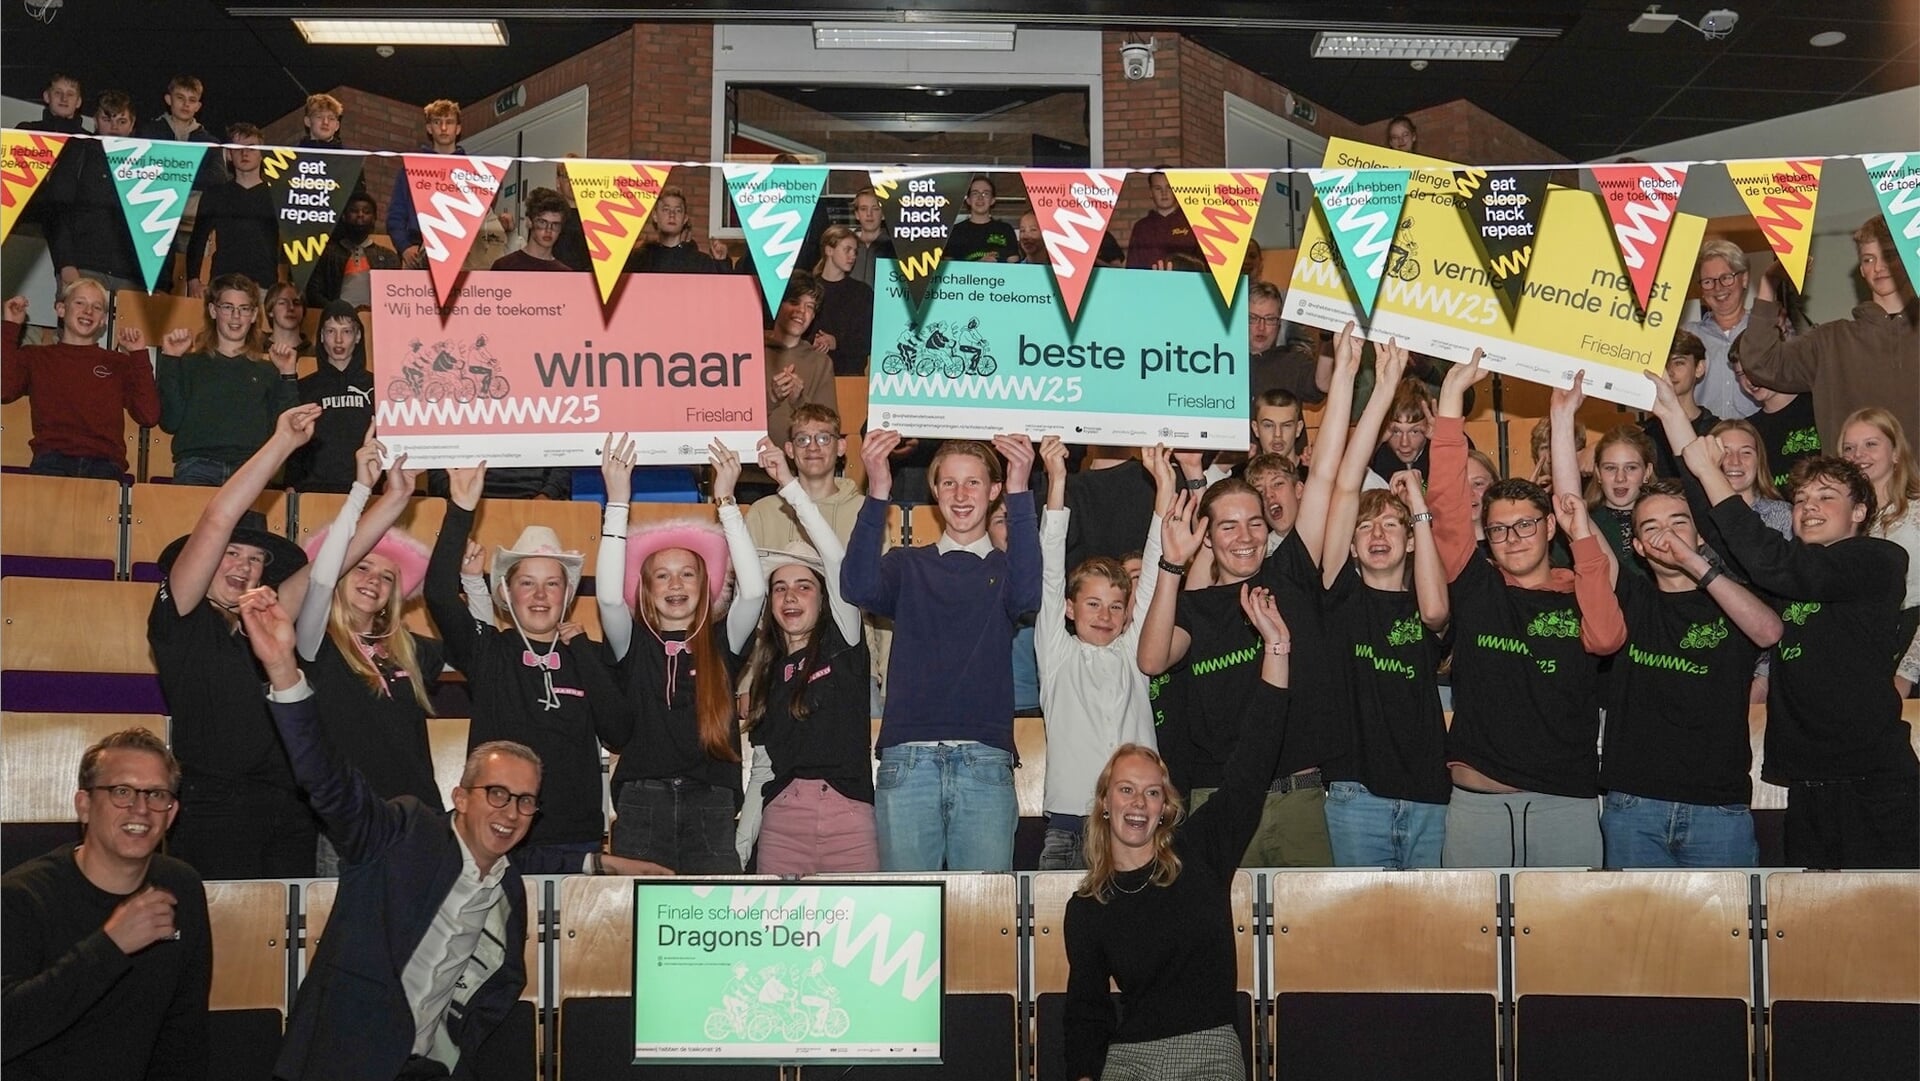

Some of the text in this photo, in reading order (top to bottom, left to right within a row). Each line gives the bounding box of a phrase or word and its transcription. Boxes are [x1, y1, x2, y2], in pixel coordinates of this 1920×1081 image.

[10, 145, 53, 157] hebben
[1, 159, 50, 170] oekomst
[148, 156, 194, 170] hebben
[298, 160, 326, 175] eat
[118, 168, 193, 183] de toekomst
[290, 174, 336, 192] sleep
[450, 169, 496, 184] hebben
[613, 176, 659, 188] hebben
[1638, 177, 1679, 189] hebben
[1772, 171, 1816, 184] hebben
[416, 179, 495, 196] de toekomst
[771, 180, 817, 192] hebben
[908, 178, 936, 193] eat
[1070, 183, 1115, 196] hebben
[1214, 183, 1259, 195] hebben
[1356, 181, 1402, 193] hebben
[1490, 177, 1516, 191] eat
[1745, 182, 1818, 196] de toekomst
[1879, 180, 1894, 191] de
[288, 191, 330, 206] hack
[581, 187, 658, 200] de toekomst
[739, 192, 817, 205] de toekomst
[1184, 195, 1259, 206] de toekomst
[1327, 194, 1402, 207] de toekomst
[1409, 188, 1468, 209] de toeko
[1485, 191, 1527, 208] sleep
[1610, 190, 1678, 201] de toekomst
[901, 193, 945, 210] sleep
[1038, 197, 1114, 209] de toekomst
[280, 207, 336, 225] repeat
[900, 208, 941, 223] hack
[1485, 206, 1524, 222] hack
[894, 225, 948, 242] repeat
[1482, 223, 1533, 240] repeat
[1591, 269, 1672, 302] mest
[968, 290, 985, 302] de
[1433, 259, 1663, 328] verniewende idee
[474, 303, 491, 316] de
[1018, 334, 1235, 380] beste pitch
[1580, 334, 1652, 365] Friesland
[534, 340, 752, 388] winnaar
[322, 395, 364, 410] PUMA
[1168, 393, 1236, 410] Friesland
[686, 407, 753, 422] Friesland
[657, 904, 849, 924] Finale scholenchallenge:
